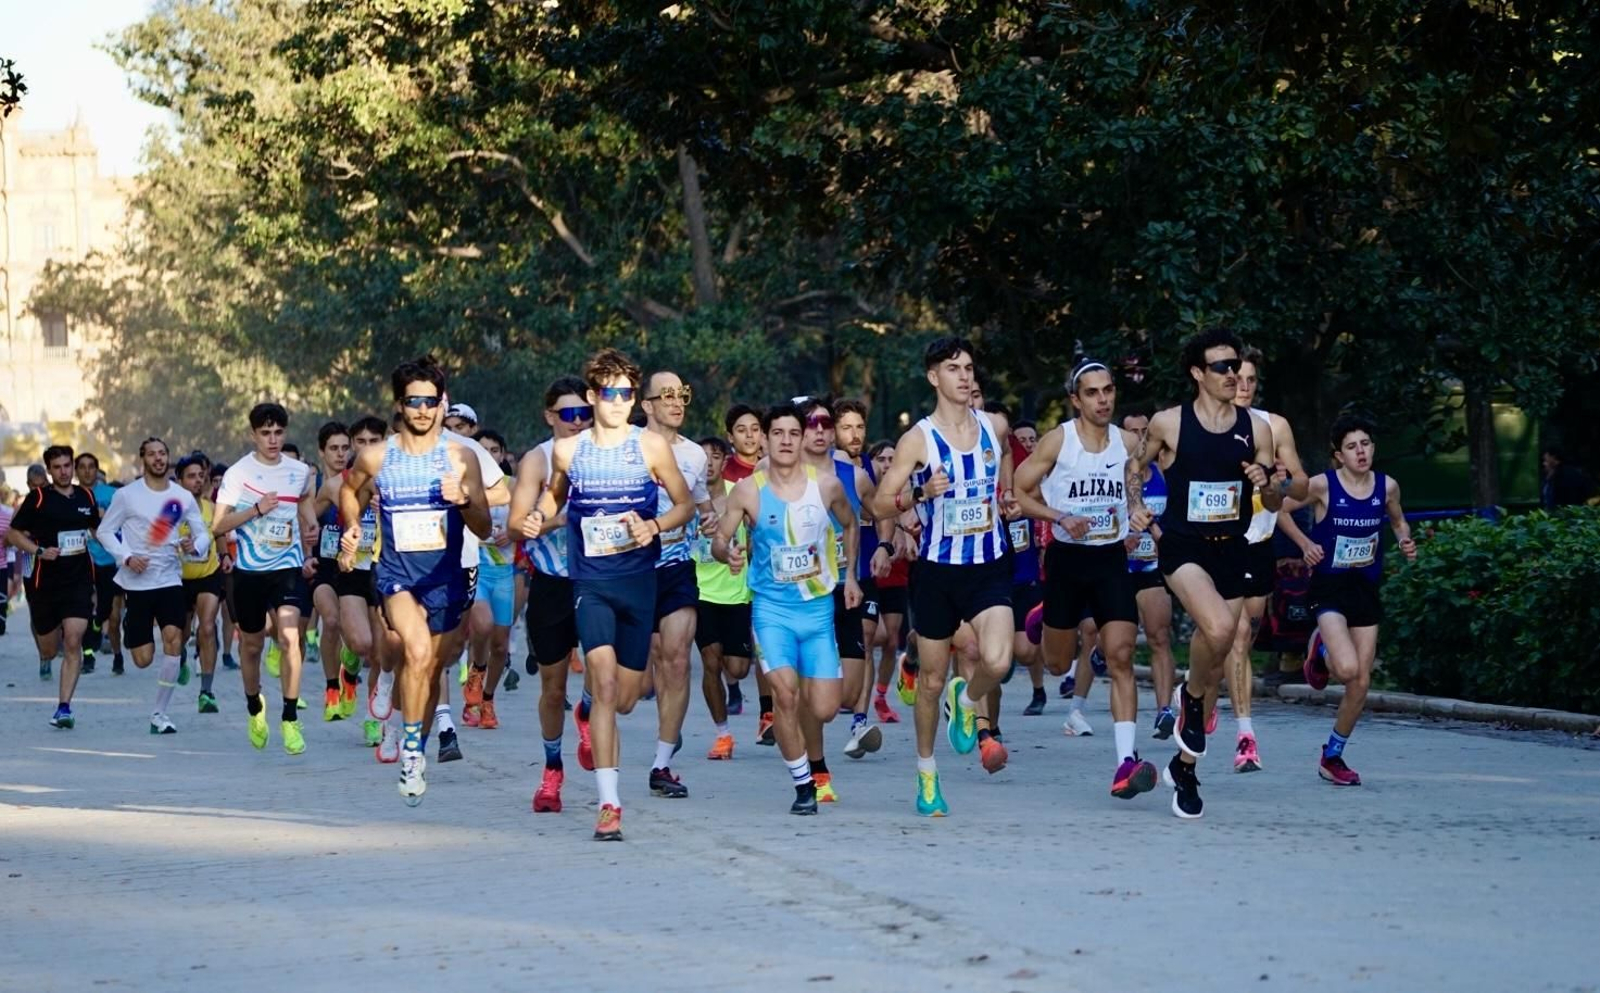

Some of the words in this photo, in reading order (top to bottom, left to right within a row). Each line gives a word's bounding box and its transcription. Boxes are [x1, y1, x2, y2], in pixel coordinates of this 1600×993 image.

[1068, 478, 1123, 500] ALIXAR
[1206, 494, 1227, 507] 698
[961, 507, 983, 521] 695
[269, 525, 286, 536] 427
[599, 526, 622, 541] 366
[1347, 545, 1371, 557] 1789
[787, 554, 809, 570] 703
